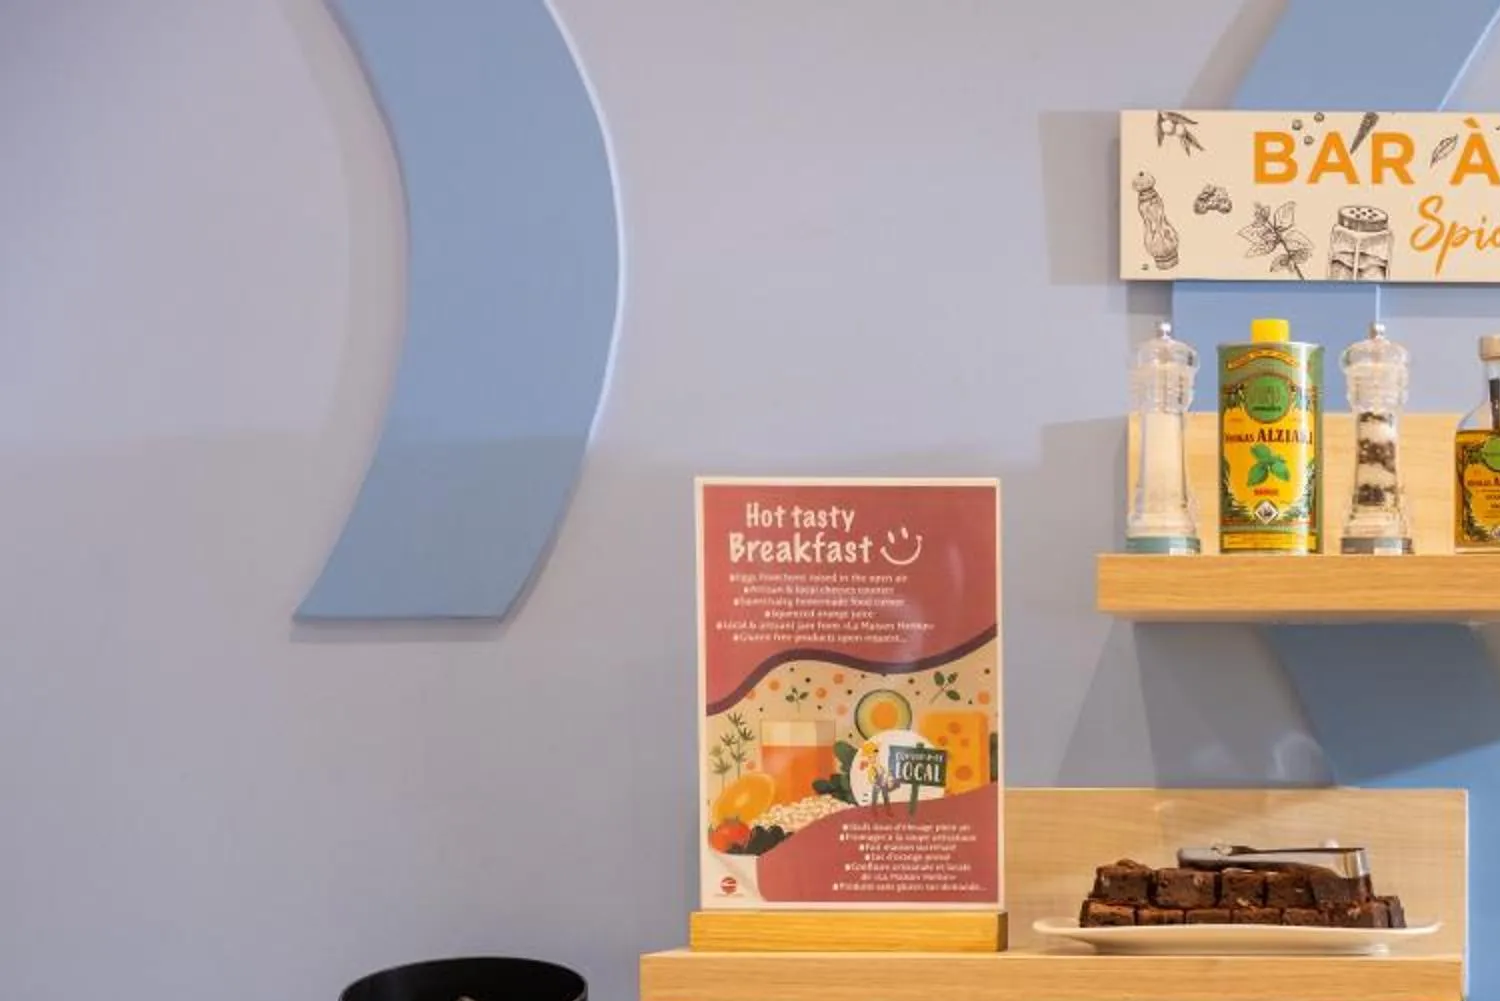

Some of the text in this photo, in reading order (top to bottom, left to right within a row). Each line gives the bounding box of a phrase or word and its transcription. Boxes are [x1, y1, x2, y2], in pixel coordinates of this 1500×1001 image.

[1253, 131, 1415, 185] BAR
[1450, 118, 1500, 186] À
[745, 502, 855, 533] Hot tasty
[728, 531, 874, 564] Breakfast
[895, 761, 940, 783] LOCAL
